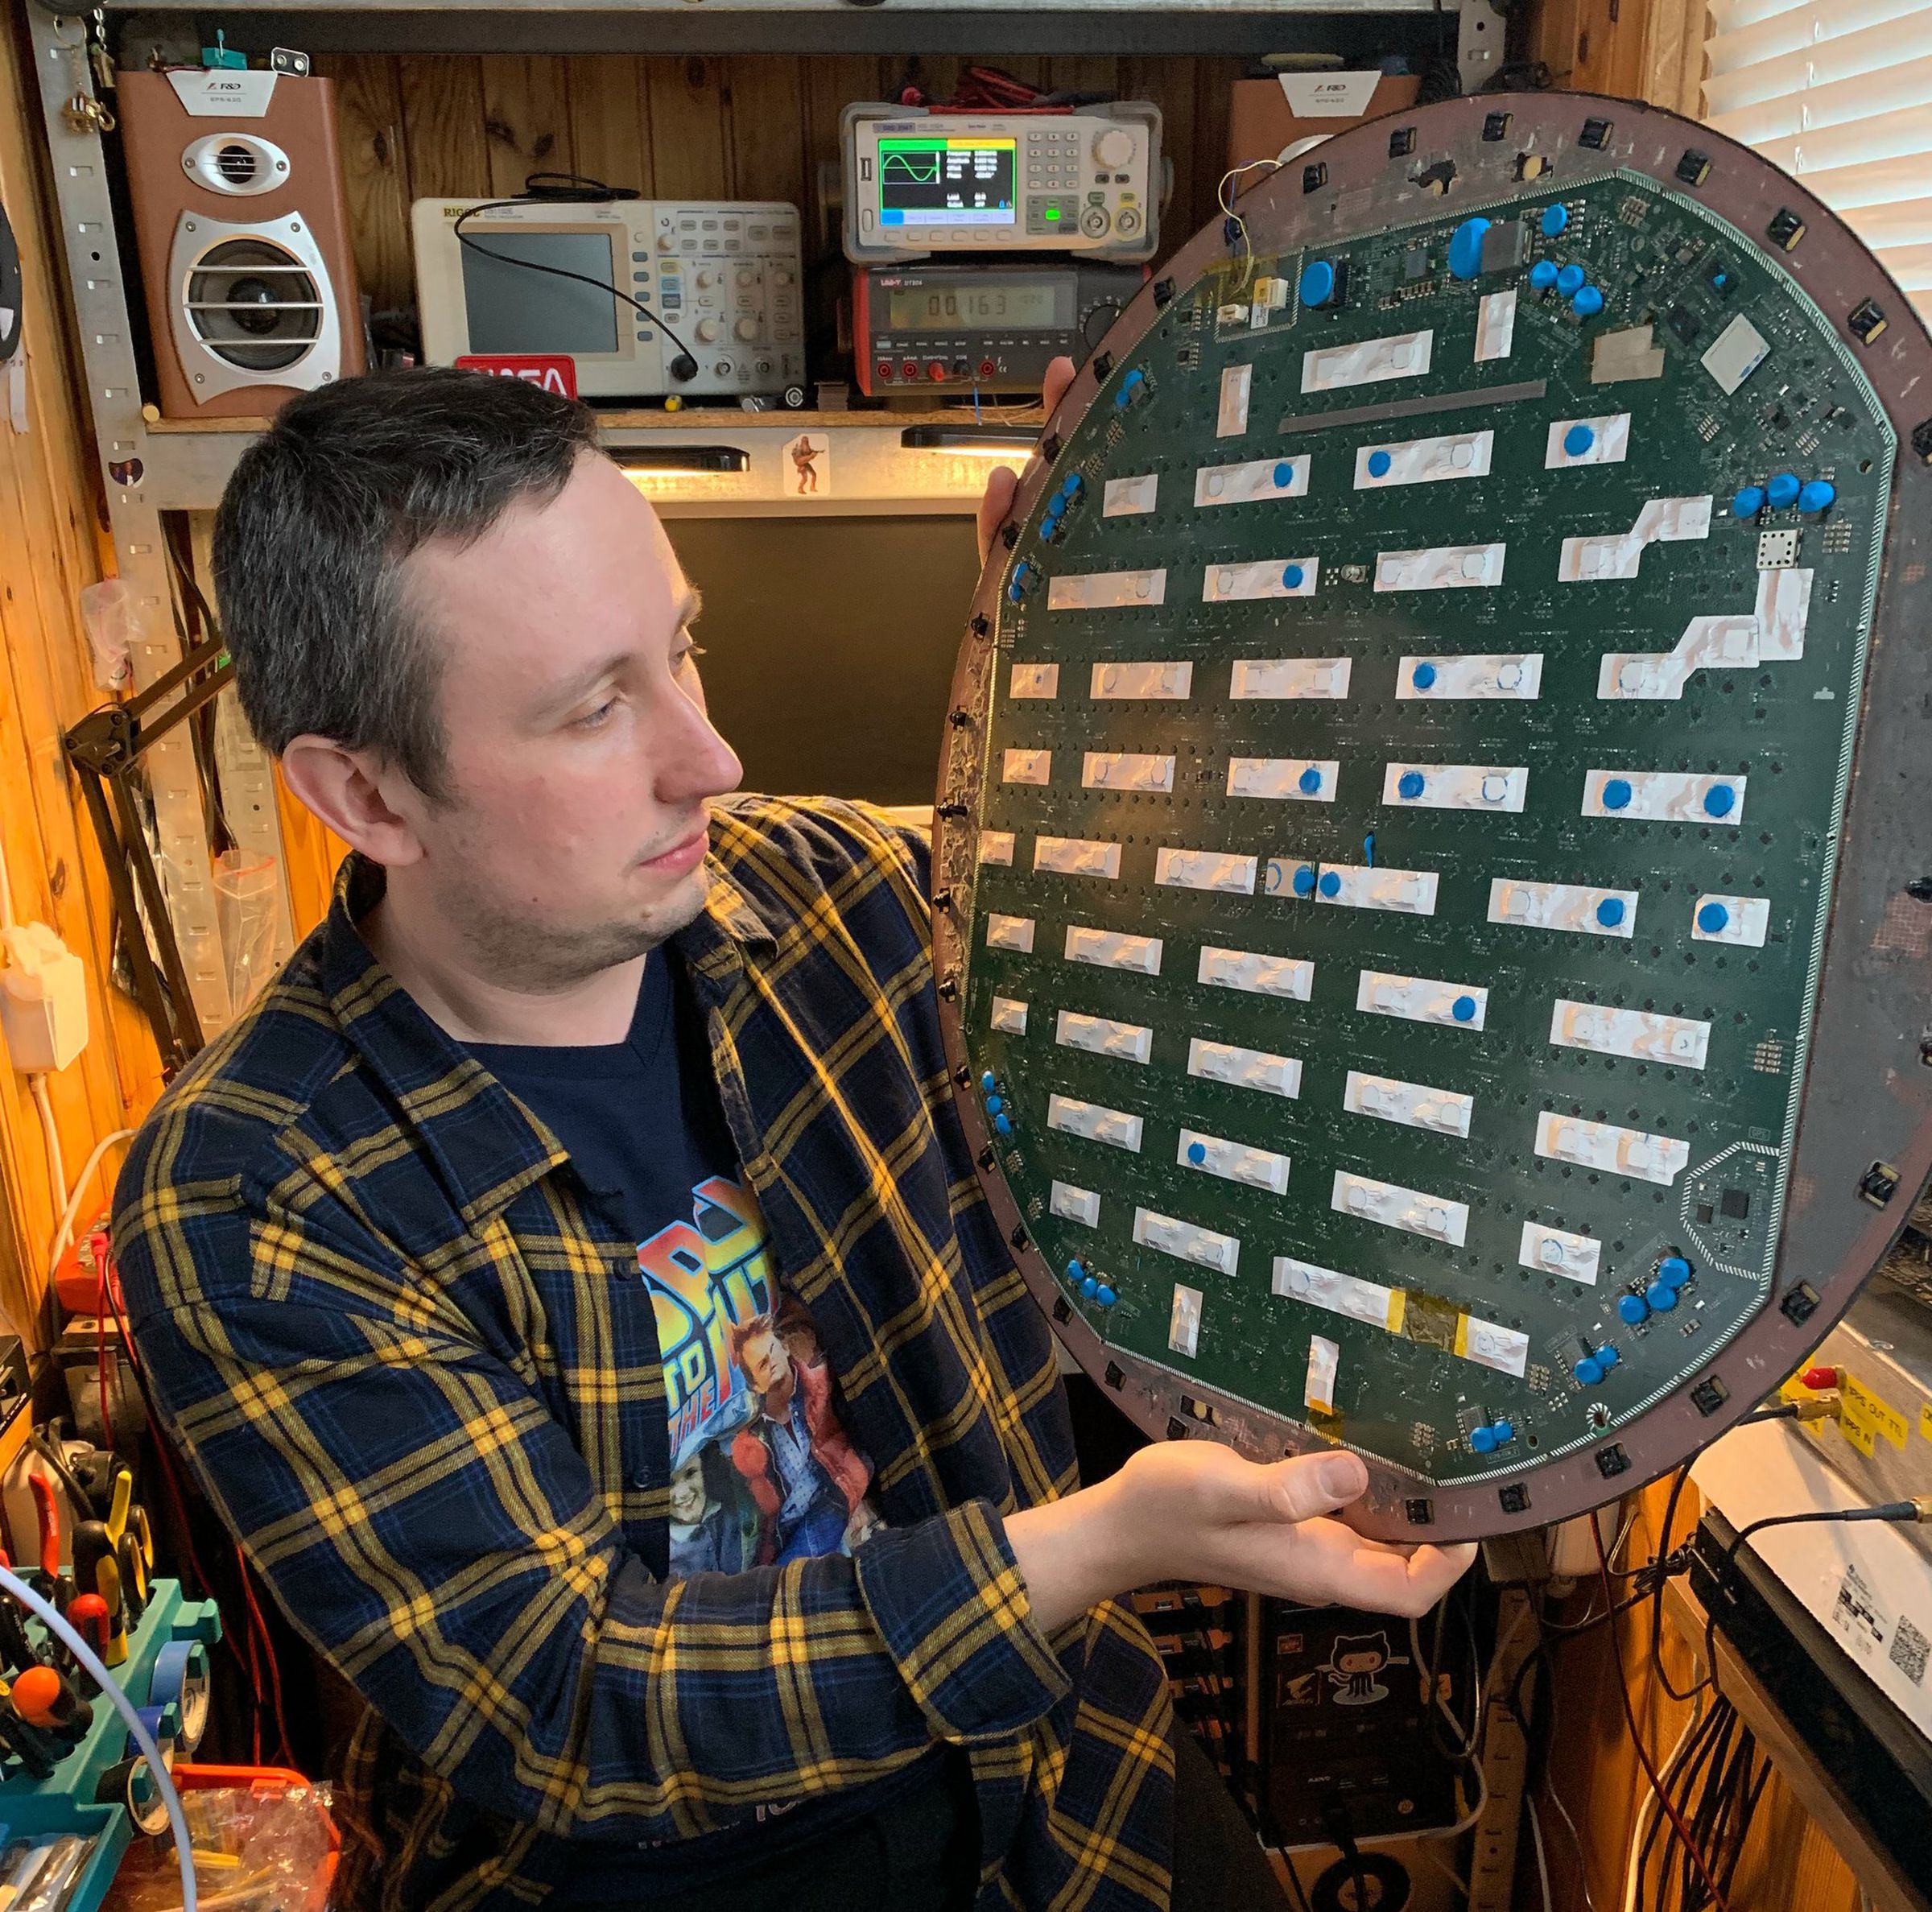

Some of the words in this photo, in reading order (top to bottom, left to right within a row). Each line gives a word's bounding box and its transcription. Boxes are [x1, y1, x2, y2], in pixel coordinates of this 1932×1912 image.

[444, 208, 481, 217] RIGL
[663, 1339, 706, 1418] TO
[667, 1375, 716, 1460] THE
[1868, 1403, 1886, 1422] OUT
